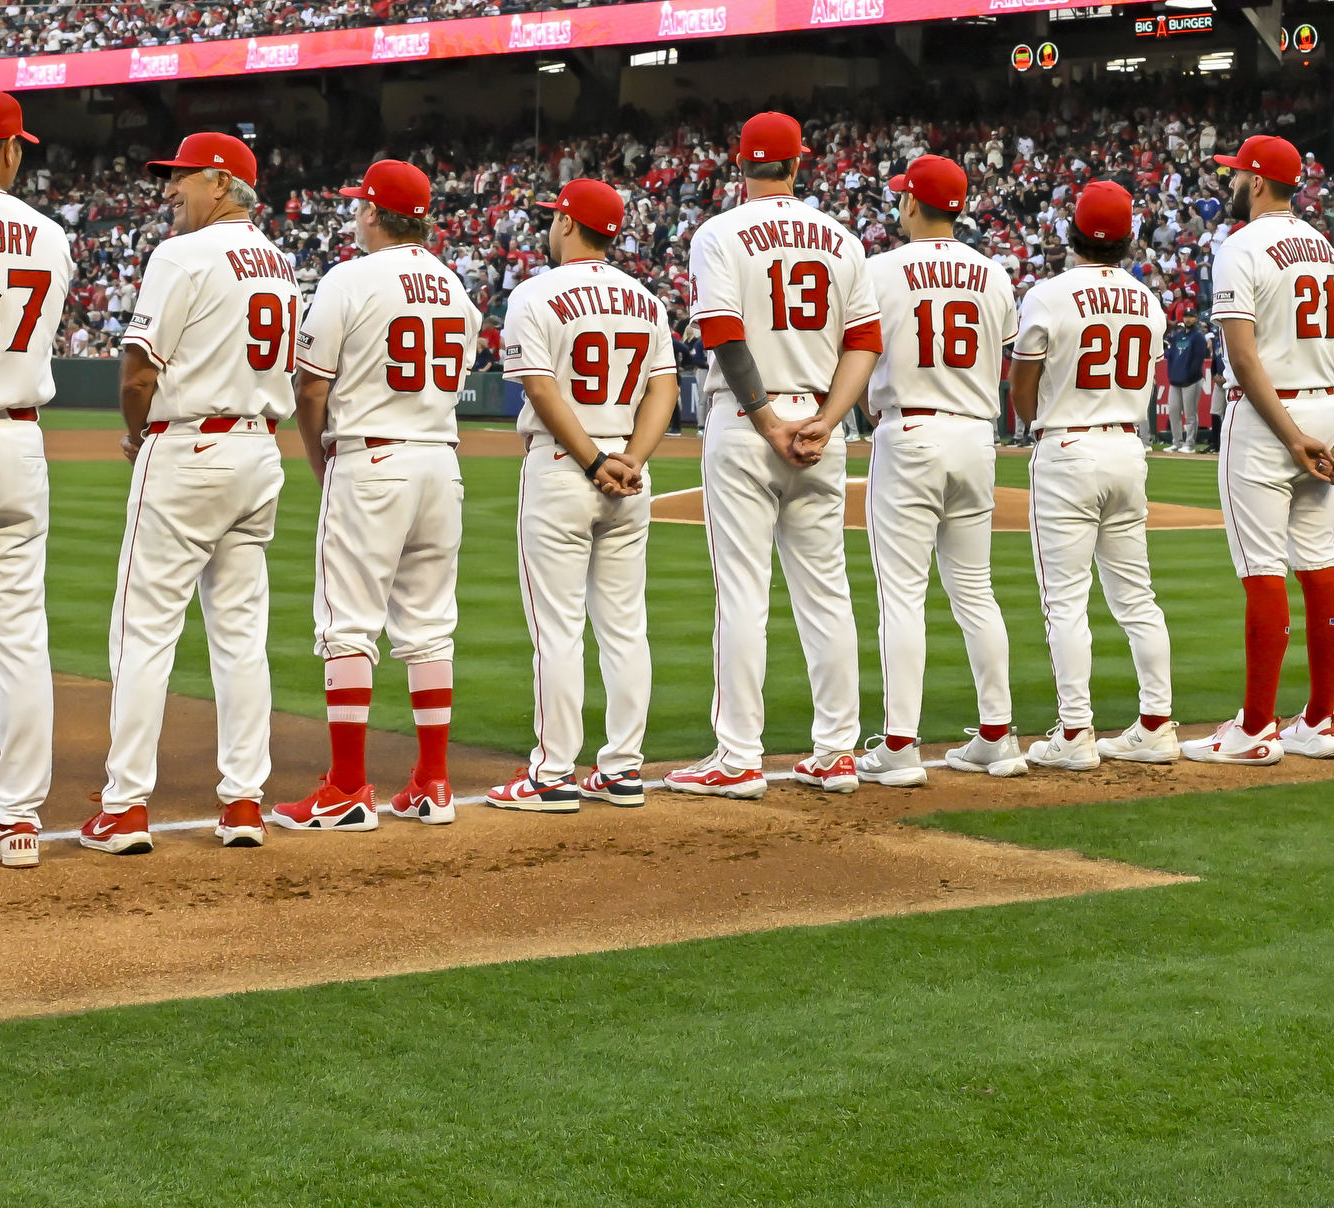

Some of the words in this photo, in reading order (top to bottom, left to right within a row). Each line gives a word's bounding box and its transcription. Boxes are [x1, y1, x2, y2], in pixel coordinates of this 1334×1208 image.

[509, 14, 571, 48] ANGELS
[658, 1, 726, 36] ANGELS
[1135, 21, 1153, 34] BIG
[1168, 16, 1213, 30] BURGER
[246, 38, 299, 69] ANGELS
[372, 27, 429, 60] ANGELS
[15, 58, 66, 88] ANGELS
[129, 48, 179, 79] ANGELS
[737, 220, 844, 259] POMERANZ
[399, 273, 451, 306] BUSS
[903, 261, 988, 293] KIKUCHI
[547, 286, 658, 326] MITTLEMAN
[767, 259, 832, 331] 13
[1072, 287, 1149, 318] FRAZIER
[246, 292, 297, 373] 91
[914, 299, 980, 369] 16
[385, 315, 466, 393] 95
[570, 331, 650, 405] 97
[1075, 323, 1152, 390] 20
